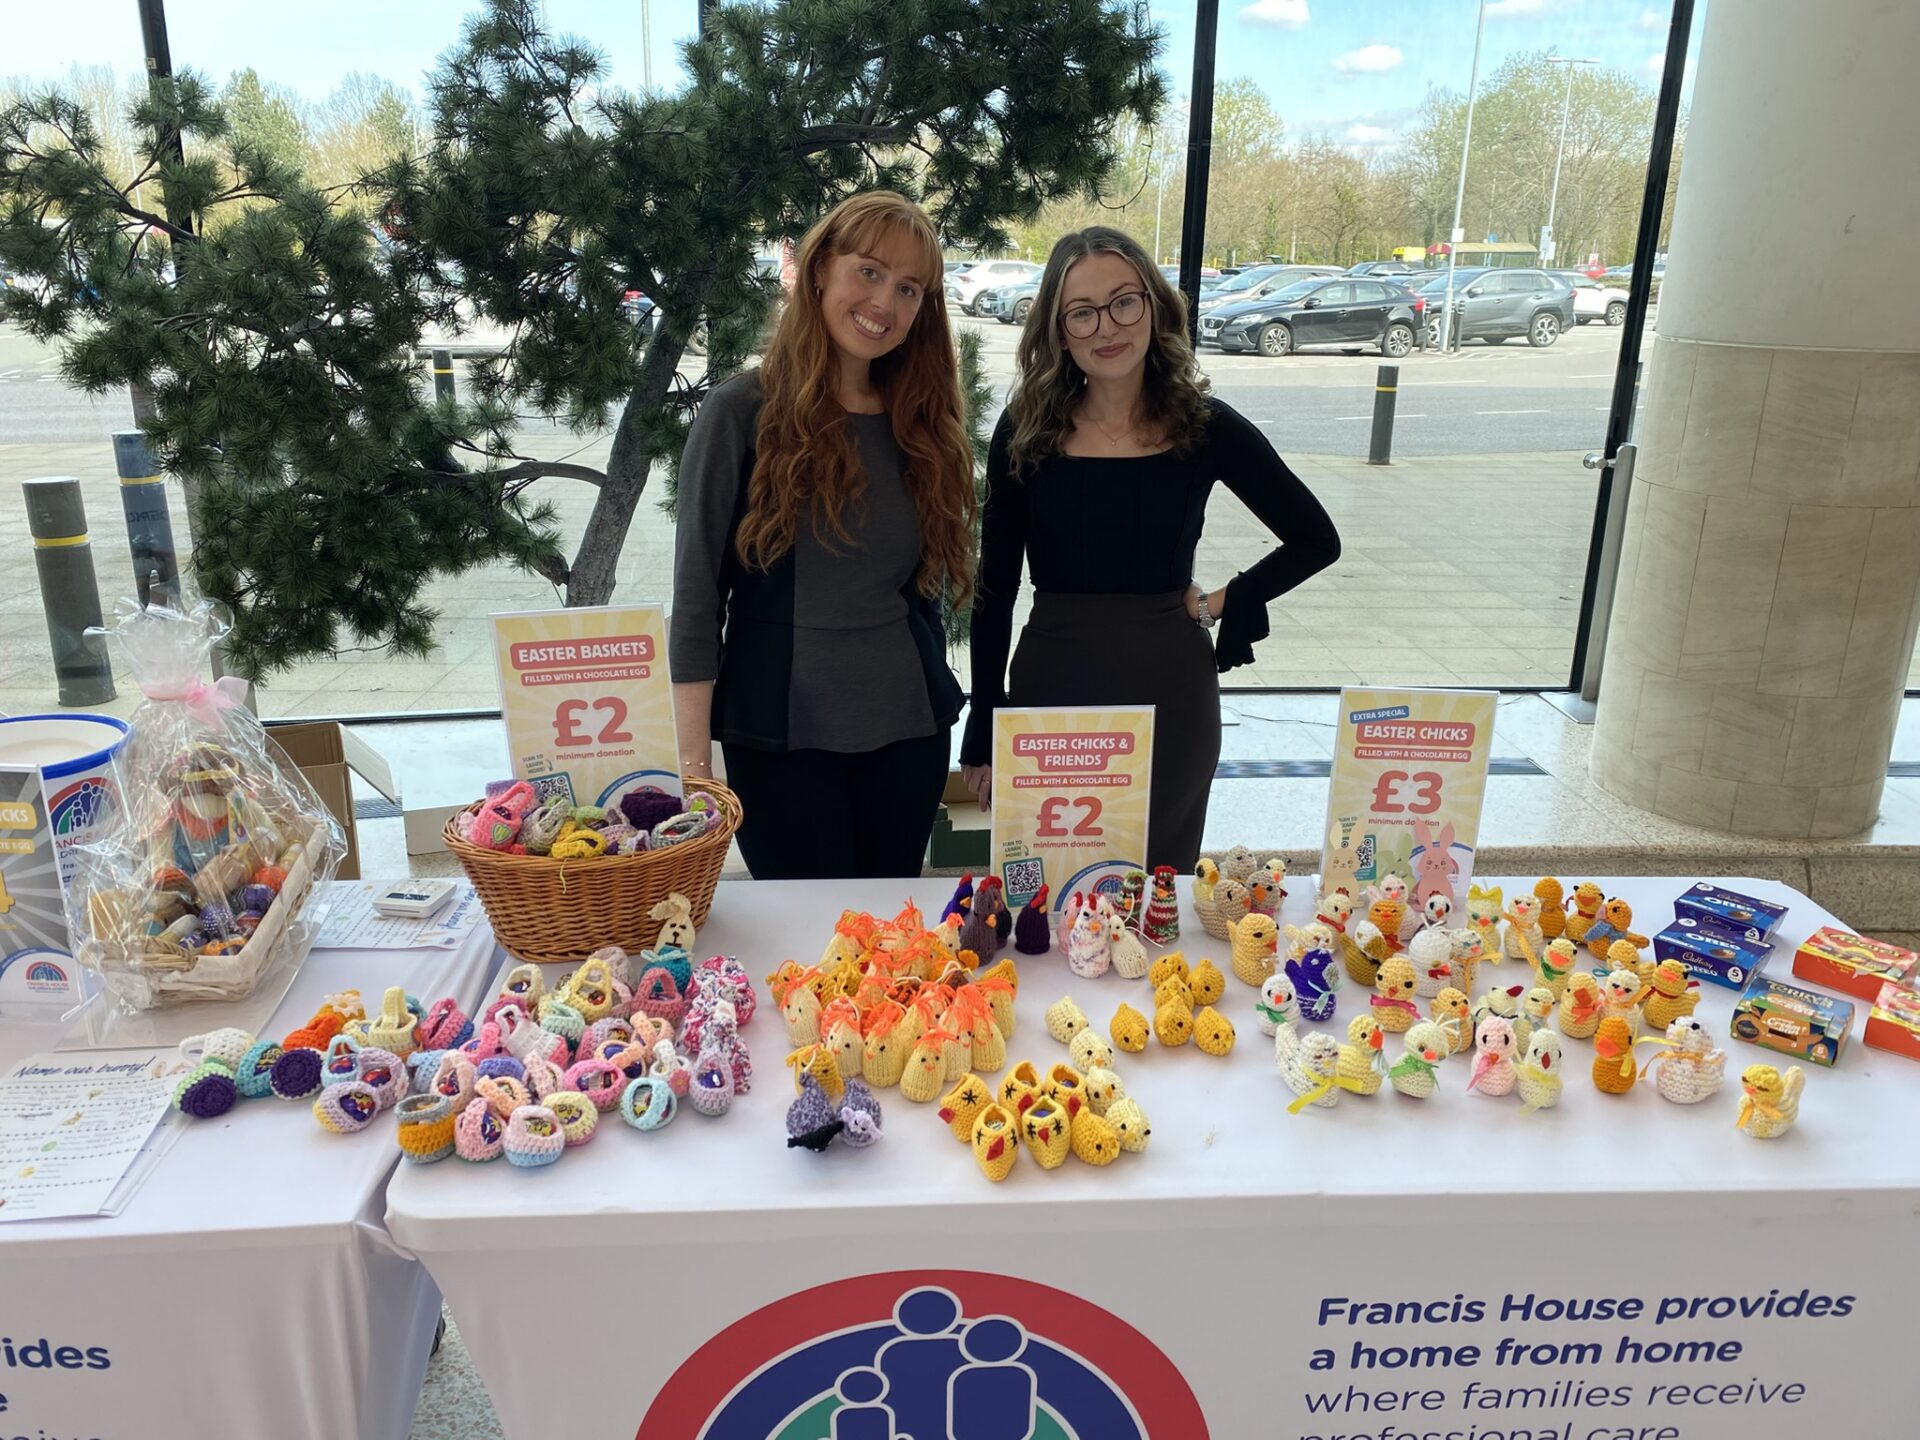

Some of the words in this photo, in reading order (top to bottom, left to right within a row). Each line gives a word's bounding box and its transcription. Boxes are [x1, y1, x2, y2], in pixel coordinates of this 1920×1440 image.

[519, 646, 576, 663] EASTER
[581, 642, 647, 659] BASKETS
[524, 674, 552, 684] FILLED
[554, 672, 574, 682] WITH
[576, 672, 582, 680] A
[583, 669, 628, 680] CHOCOLATE
[630, 668, 647, 676] EGG
[552, 696, 633, 746] £2
[1354, 711, 1376, 721] EXTRA
[1377, 708, 1406, 718] SPECIAL
[1364, 725, 1416, 739] EASTER
[1419, 727, 1468, 741] CHICKS
[1019, 738, 1067, 750] EASTER
[1070, 738, 1115, 750] CHICKS
[1118, 738, 1128, 749] &
[556, 750, 594, 761] minimum
[596, 748, 635, 758] donation
[1044, 754, 1102, 766] FRIENDS
[1410, 751, 1452, 760] CHOCOLATE
[1370, 770, 1443, 814] £3
[0, 808, 28, 823] CKS
[1036, 796, 1103, 837] £2
[1368, 817, 1403, 826] minimum
[1404, 817, 1440, 826] dotion
[56, 833, 94, 849] ANCIS
[1033, 840, 1068, 849] minimum
[1070, 840, 1106, 848] donation
[1686, 933, 1740, 950] OREO
[1749, 930, 1756, 938] 5
[1682, 952, 1713, 969] Cadbury
[1731, 968, 1739, 977] 5
[13, 1063, 63, 1077] Name
[64, 1066, 94, 1075] our
[96, 1056, 156, 1076] bunny!
[1318, 1294, 1486, 1326] Francis
[1500, 1294, 1644, 1323] House
[1655, 1288, 1856, 1325] provides
[0, 1338, 111, 1370] ides
[1309, 1348, 1335, 1370] a
[1350, 1341, 1481, 1369] home
[1495, 1337, 1600, 1366] from
[1615, 1336, 1743, 1364] home
[1305, 1384, 1445, 1414] where
[1462, 1380, 1633, 1410] families
[1648, 1377, 1806, 1406] receive
